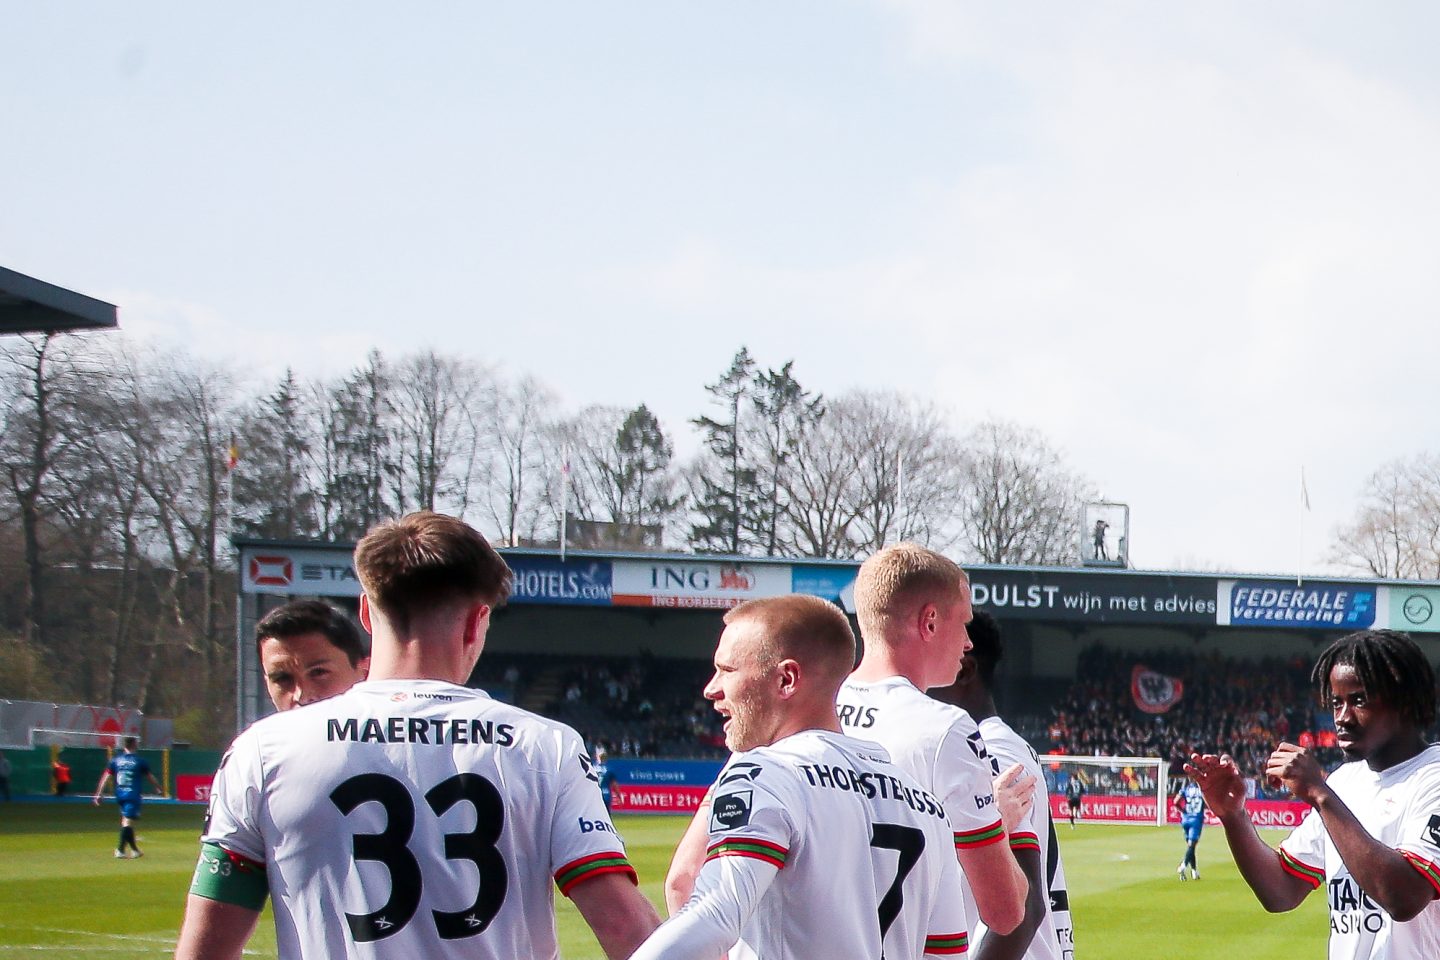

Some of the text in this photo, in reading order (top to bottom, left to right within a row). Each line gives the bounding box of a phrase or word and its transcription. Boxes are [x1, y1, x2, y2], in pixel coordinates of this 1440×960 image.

[651, 566, 710, 590] ING
[1063, 593, 1101, 613] wijn
[1109, 596, 1146, 611] met
[1154, 595, 1215, 613] advies
[1234, 588, 1347, 610] FEDERALE
[327, 717, 514, 747] MAERTENS
[631, 793, 673, 807] MATE!
[676, 795, 700, 807] 21+
[1093, 803, 1120, 817] MET
[329, 772, 508, 944] 33
